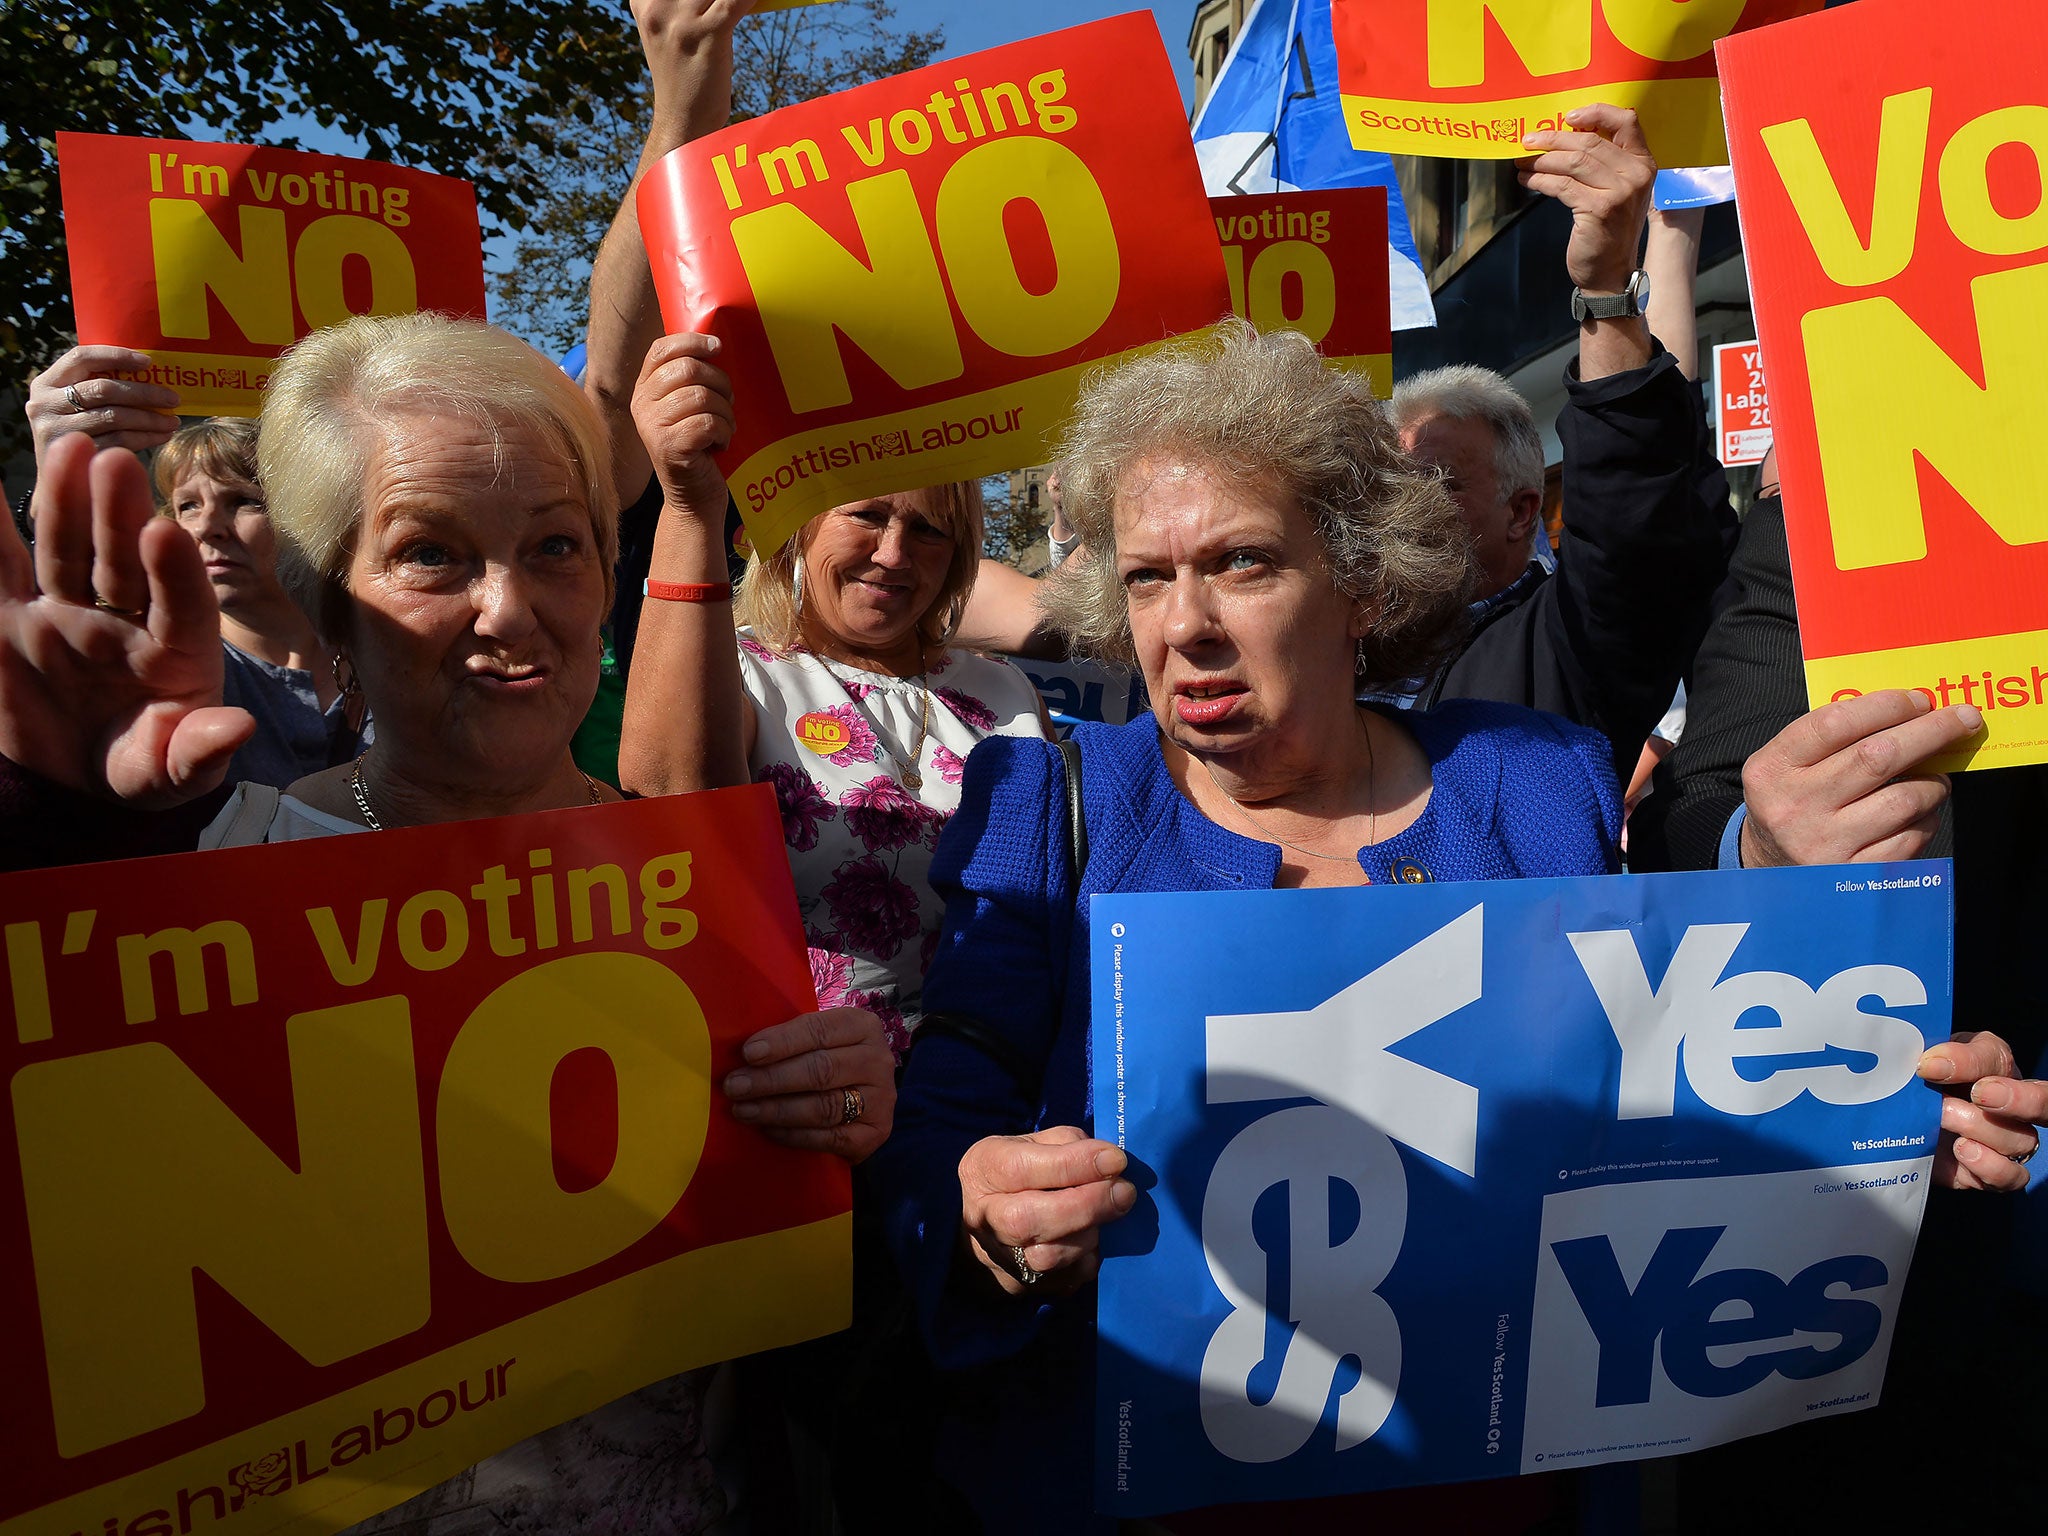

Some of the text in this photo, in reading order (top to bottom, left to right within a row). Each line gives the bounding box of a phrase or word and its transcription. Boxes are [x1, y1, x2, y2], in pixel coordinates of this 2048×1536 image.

[709, 68, 1079, 211] I'm voting
[1360, 109, 1492, 141] Scottish
[149, 152, 411, 227] I'm voting
[1215, 205, 1331, 244] voting
[149, 198, 418, 345] NO
[730, 135, 1121, 415] NO
[745, 406, 1026, 514] Scottish Labour
[805, 721, 841, 741] NO
[1835, 880, 1866, 892] Follow
[4, 847, 700, 1045] I'm voting
[1113, 943, 1123, 971] Please
[1113, 971, 1124, 1001] display
[1115, 1002, 1125, 1018] this
[1566, 922, 1929, 1121] Yes
[1115, 1019, 1126, 1052] window
[1115, 1053, 1125, 1080] poster
[1117, 1081, 1126, 1091] to
[1117, 1091, 1127, 1114] show
[1116, 1114, 1126, 1134] your
[1607, 1163, 1618, 1171] this
[1619, 1162, 1641, 1170] window
[1666, 1158, 1682, 1166] show
[1683, 1157, 1696, 1166] your
[1200, 902, 1484, 1464] Yes
[1813, 1183, 1843, 1195] Follow
[10, 951, 713, 1460] NO
[1495, 1313, 1510, 1351] Follow
[1550, 1224, 1890, 1408] Yes
[294, 1357, 518, 1486] Labour
[1642, 1440, 1657, 1449] show
[1657, 1439, 1670, 1447] your
